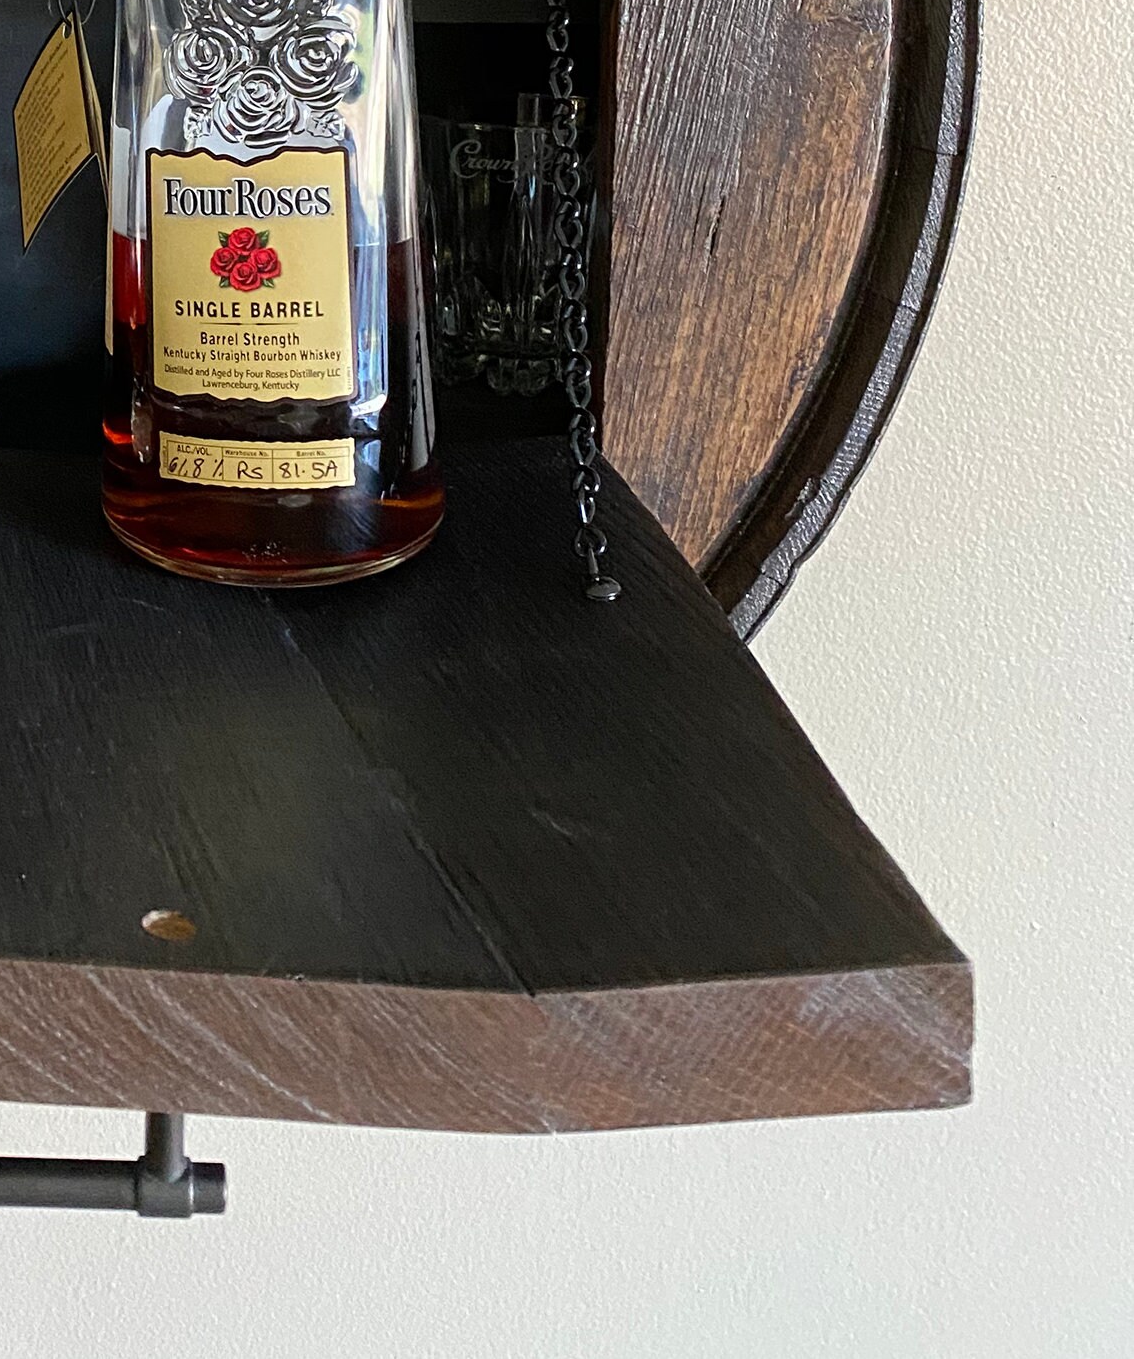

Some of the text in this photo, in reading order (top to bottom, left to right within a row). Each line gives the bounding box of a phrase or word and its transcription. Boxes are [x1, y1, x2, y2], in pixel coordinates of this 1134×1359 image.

[450, 139, 519, 179] Crown
[162, 178, 332, 218] Four Roses
[175, 299, 324, 318] SINGLE BARREL
[200, 331, 300, 348] Barrel Strength
[163, 346, 341, 363] Kentucky Straight Bourbon Whiskey
[164, 364, 341, 380] Distilled and Aged by Four Roses Distillery LLC
[202, 378, 300, 391] Lawrenceburg, Kentucky
